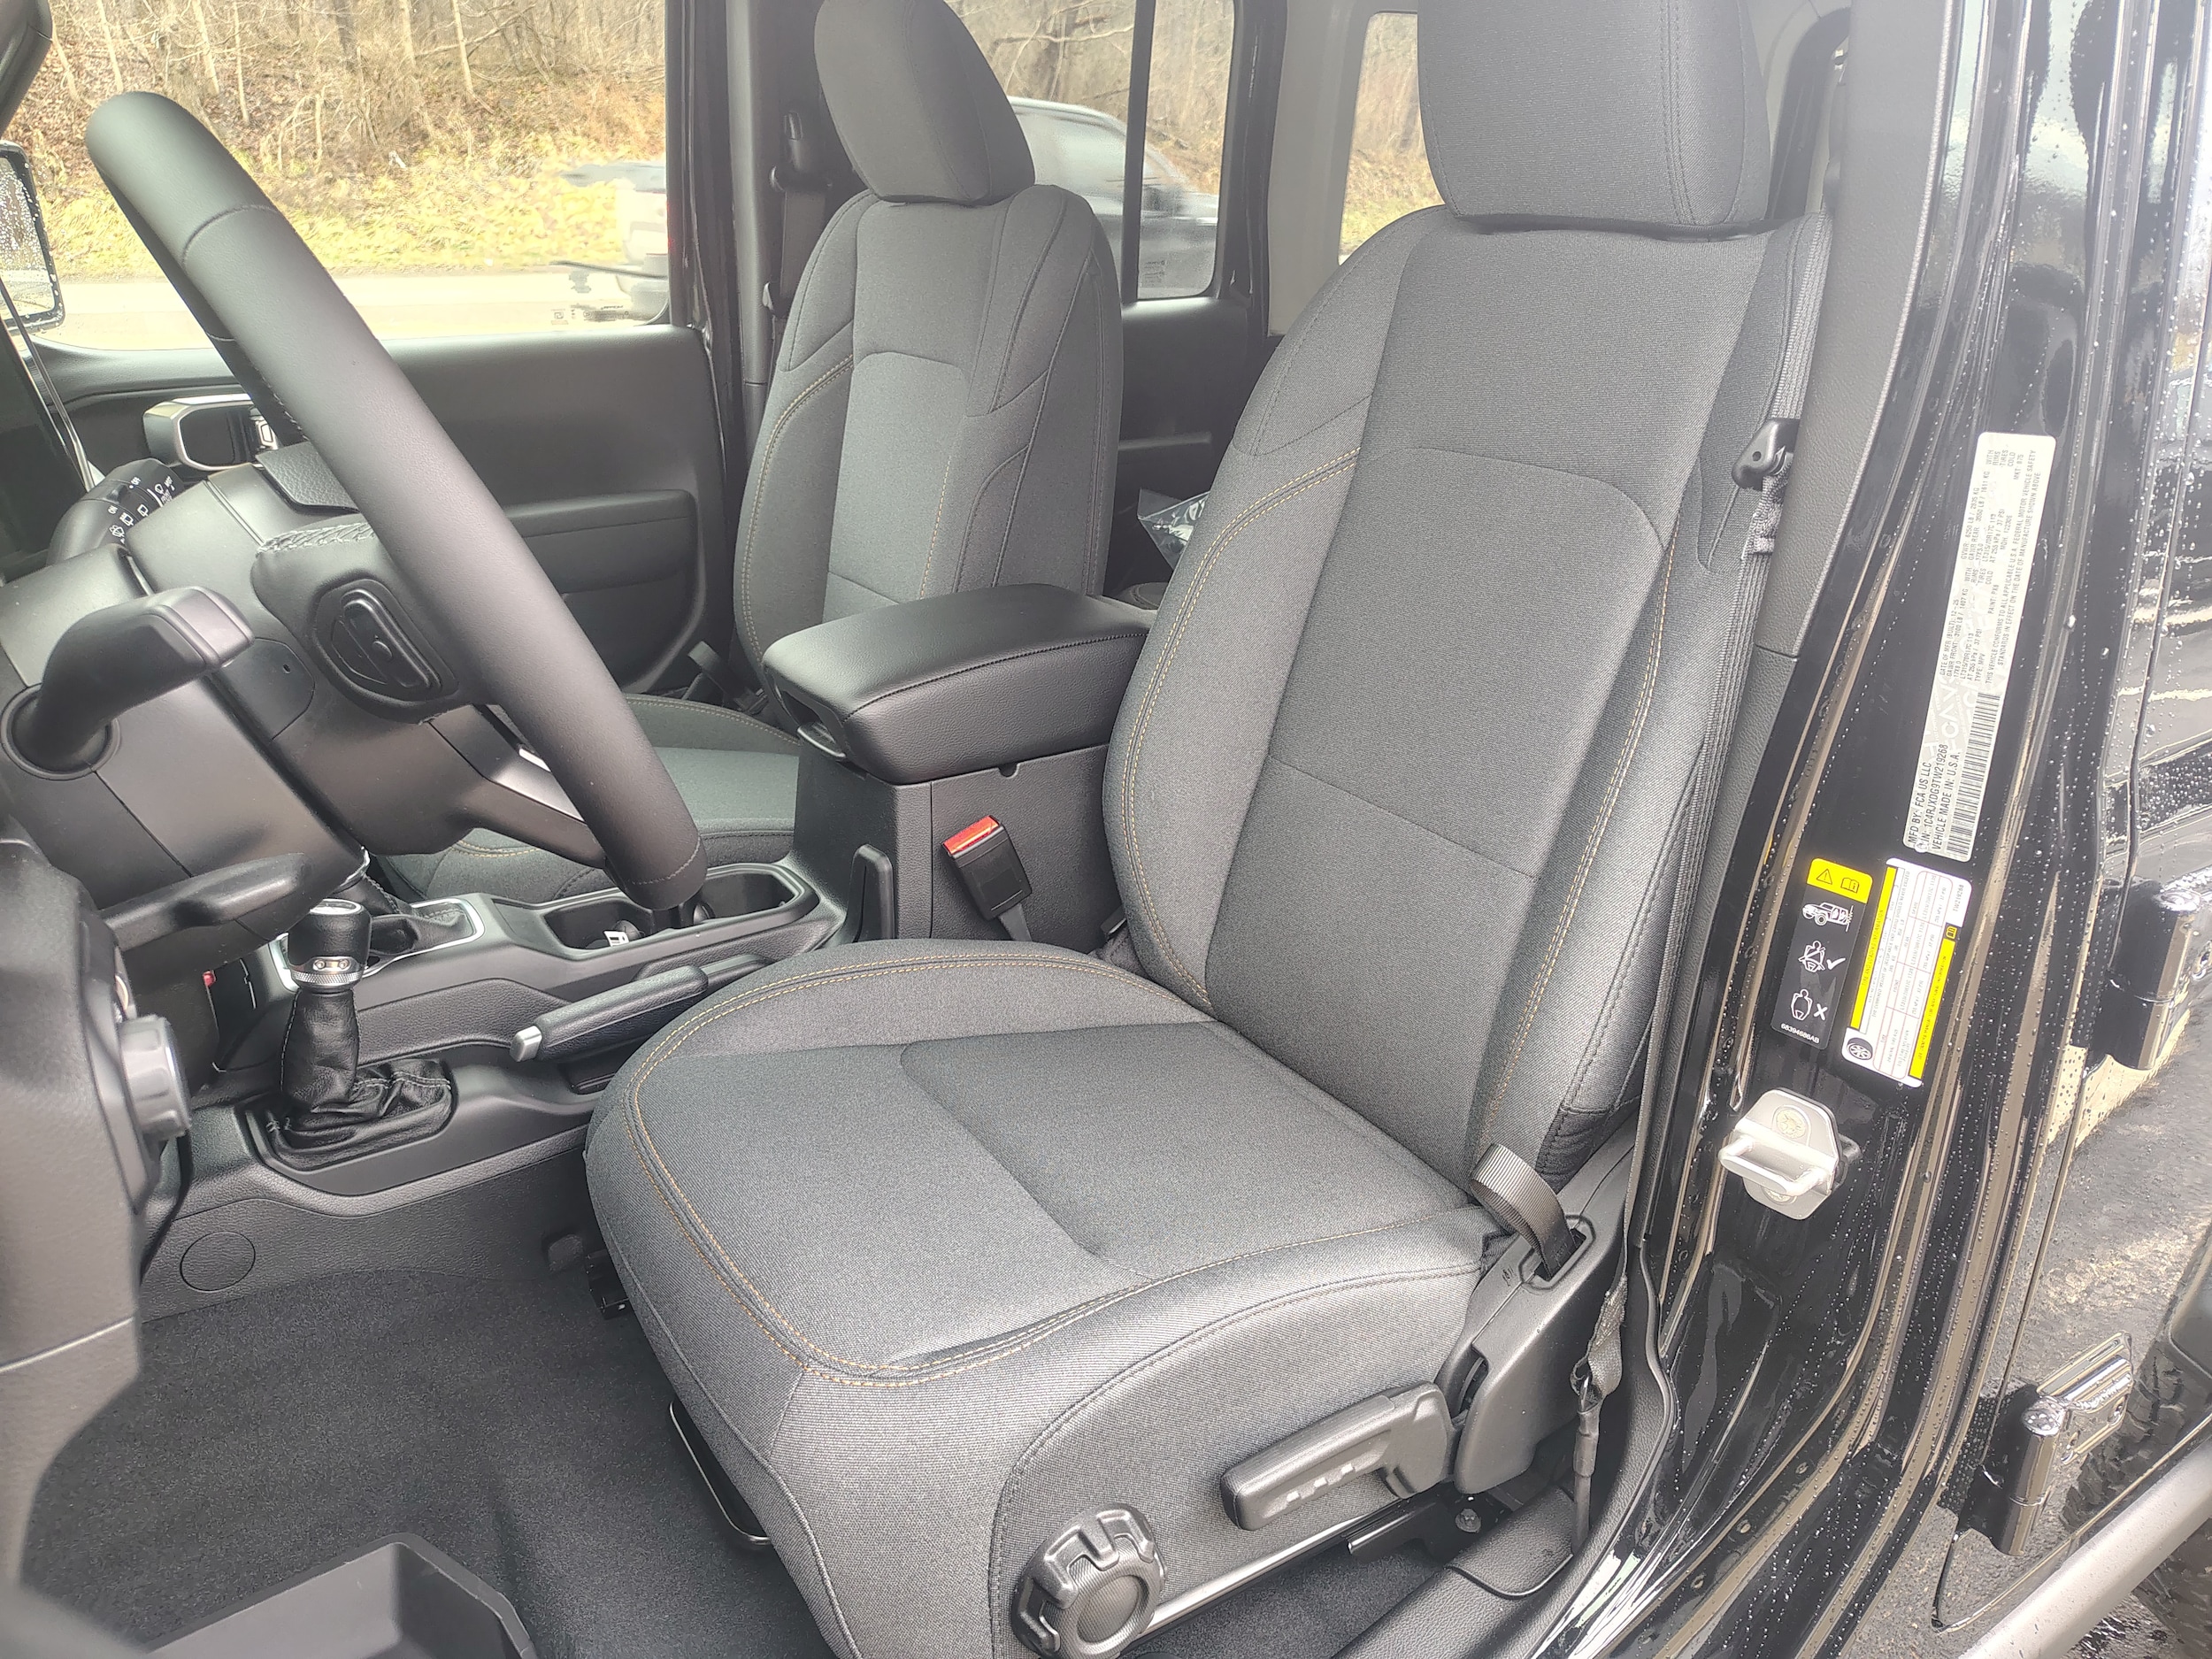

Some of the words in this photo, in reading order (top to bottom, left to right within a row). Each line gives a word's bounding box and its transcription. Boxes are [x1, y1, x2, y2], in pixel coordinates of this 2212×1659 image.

[2027, 450, 2036, 472] SAFETY
[2023, 474, 2032, 495] VEHICLE
[108, 504, 119, 514] ON
[2018, 498, 2027, 518] MOTOR
[2013, 520, 2024, 544] FEDERAL
[1978, 568, 1986, 583] TIRES
[1998, 634, 2009, 665] STANDARDS
[2005, 605, 2015, 625] EFFECT
[2014, 567, 2023, 581] DATE
[2019, 516, 2032, 557] MANUFACTURE
[2027, 493, 2036, 513] SHOWN
[2003, 565, 2015, 596] APPLICABLE
[1988, 649, 1998, 670] VEHICLE
[1921, 762, 1932, 776] LLC
[1947, 752, 1960, 776] U.S.A.
[1918, 779, 1928, 789] US
[1924, 744, 1947, 827] 1C4RJXDG9TW219268
[1944, 779, 1955, 790] IN:
[1915, 793, 1925, 807] FCA
[1939, 793, 1952, 815] MADE
[1911, 810, 1922, 824] BY:
[1908, 826, 1918, 843] MFD
[1919, 831, 1932, 849] IN:
[1932, 818, 1947, 849] VEHICLE
